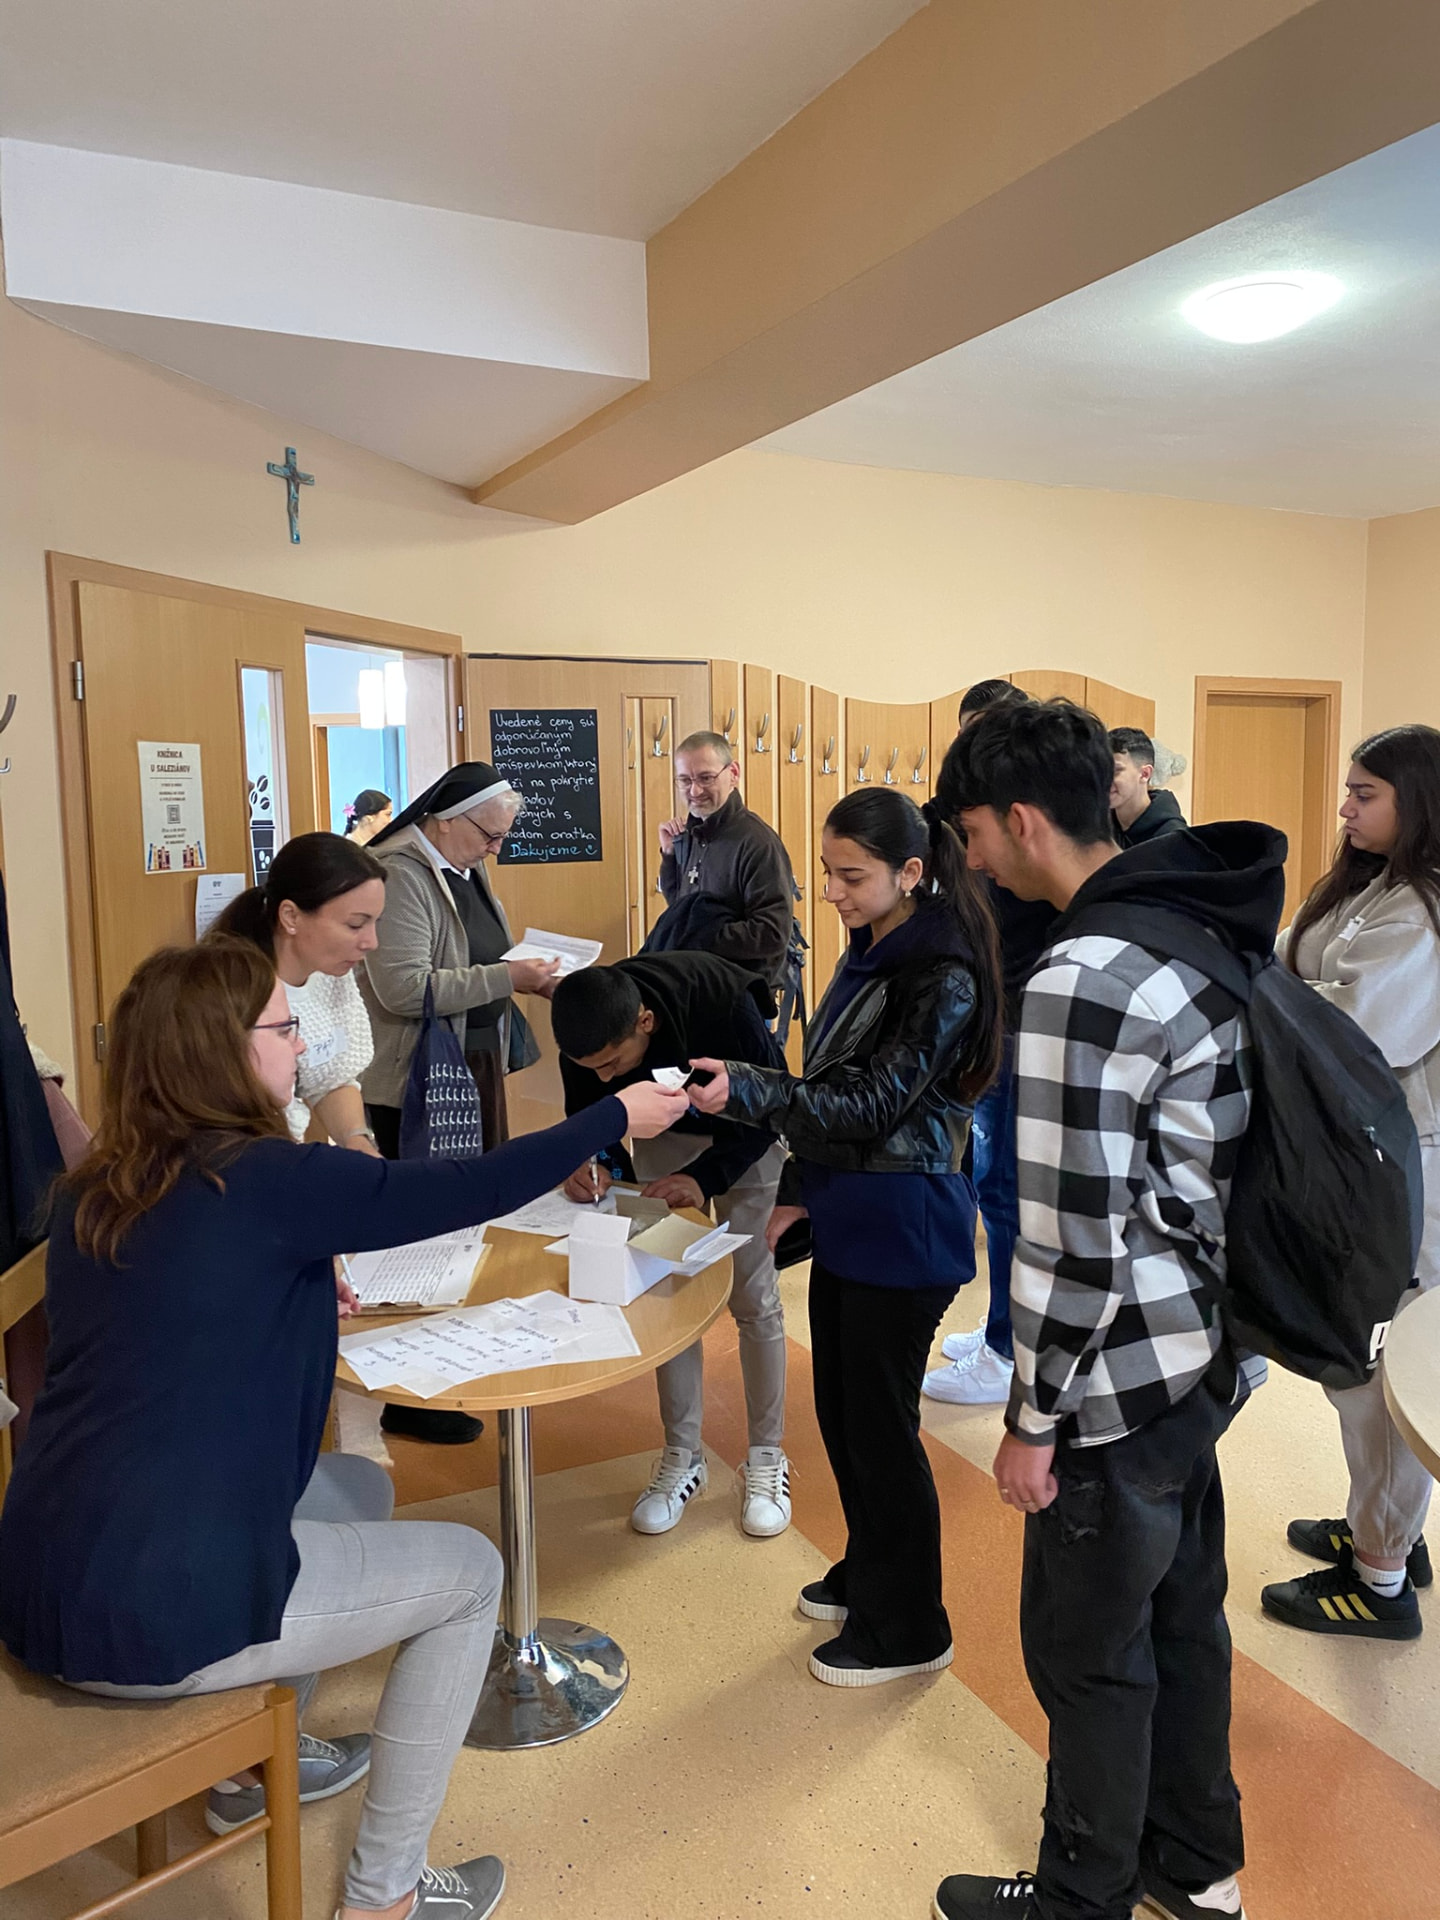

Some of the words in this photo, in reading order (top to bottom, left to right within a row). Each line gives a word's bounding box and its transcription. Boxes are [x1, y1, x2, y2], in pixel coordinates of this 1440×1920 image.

[495, 712, 542, 727] Uvedené
[549, 718, 575, 731] ceny
[580, 714, 595, 727] sú
[493, 741, 571, 759] dobrovoľným
[530, 779, 545, 788] na
[551, 773, 595, 792] pokrytie
[523, 792, 555, 806] adov
[563, 810, 572, 820] s
[550, 826, 597, 840] oratka
[509, 841, 582, 861] Ďakujeme
